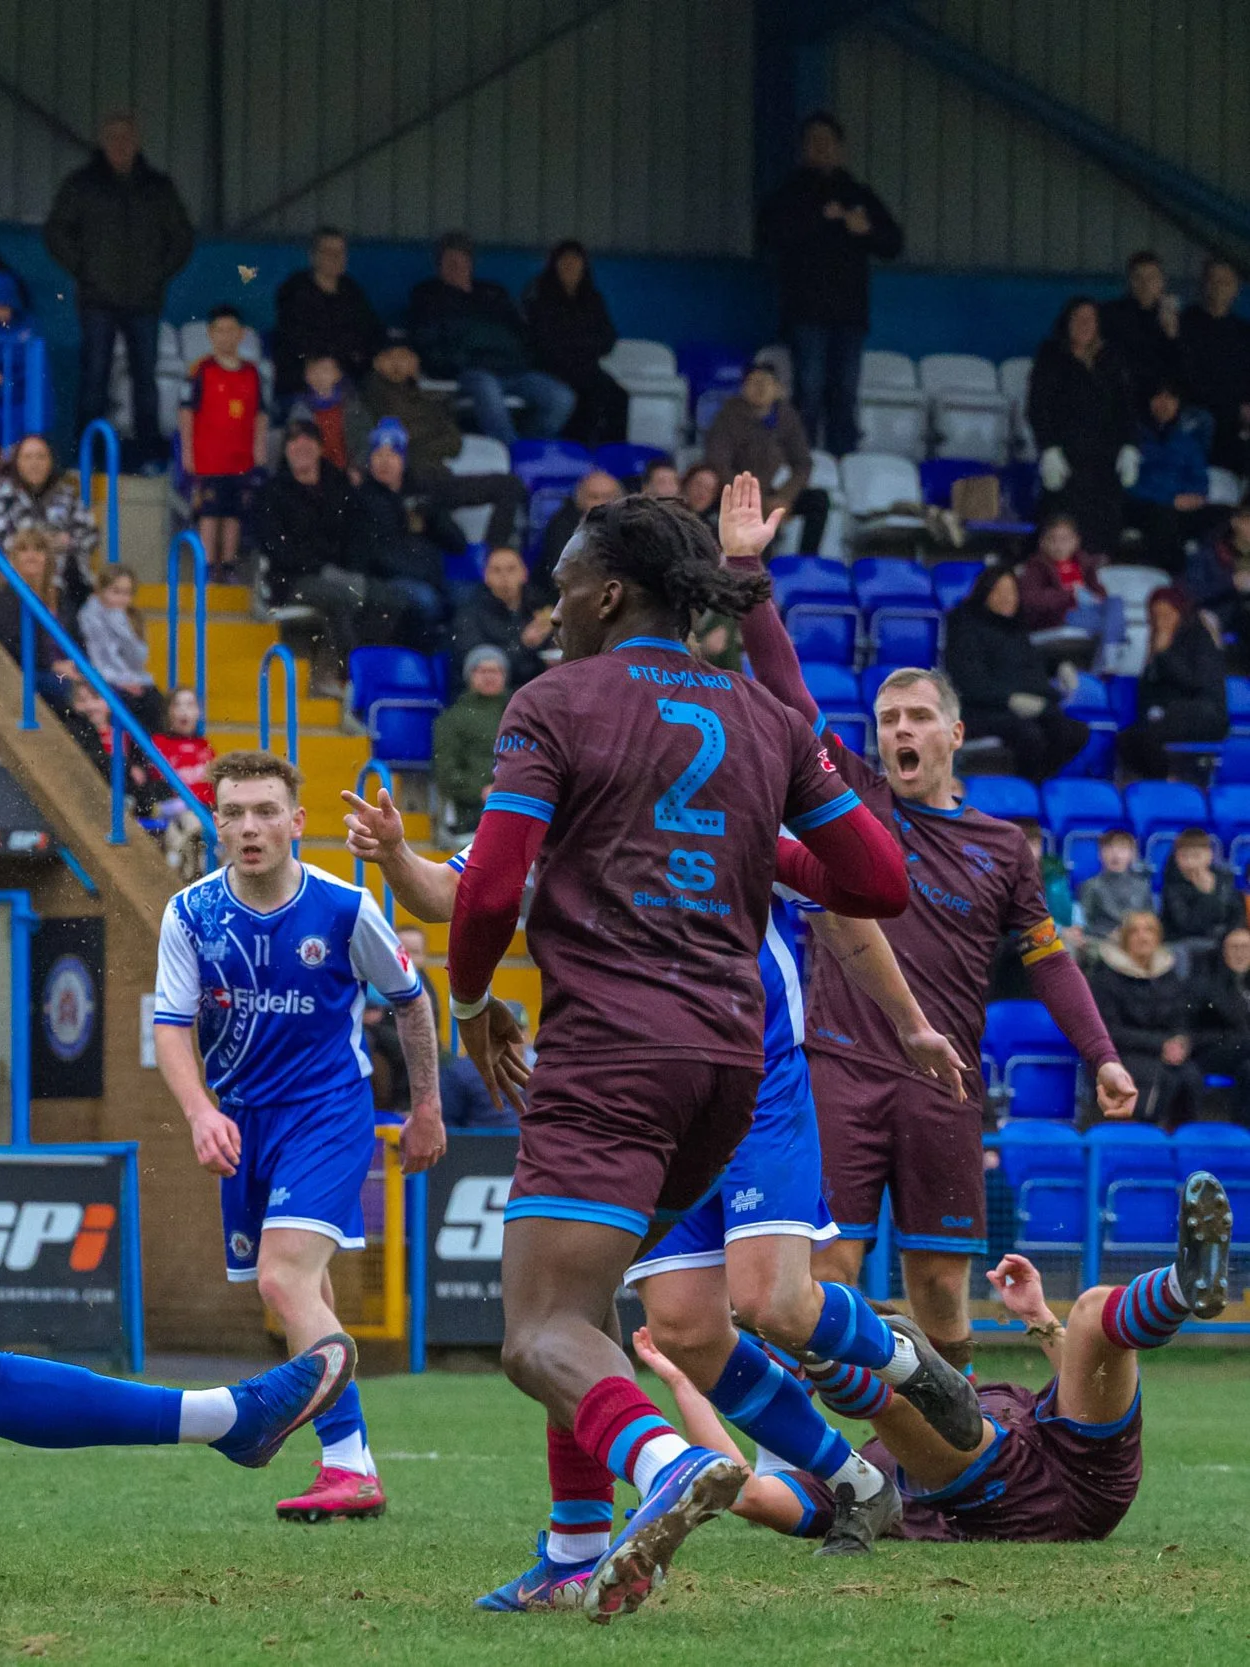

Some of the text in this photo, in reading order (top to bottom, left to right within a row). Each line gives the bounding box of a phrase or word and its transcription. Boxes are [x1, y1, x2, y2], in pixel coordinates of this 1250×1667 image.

[654, 698, 726, 837] 2
[253, 934, 270, 967] 11
[233, 988, 315, 1015] Fidelis
